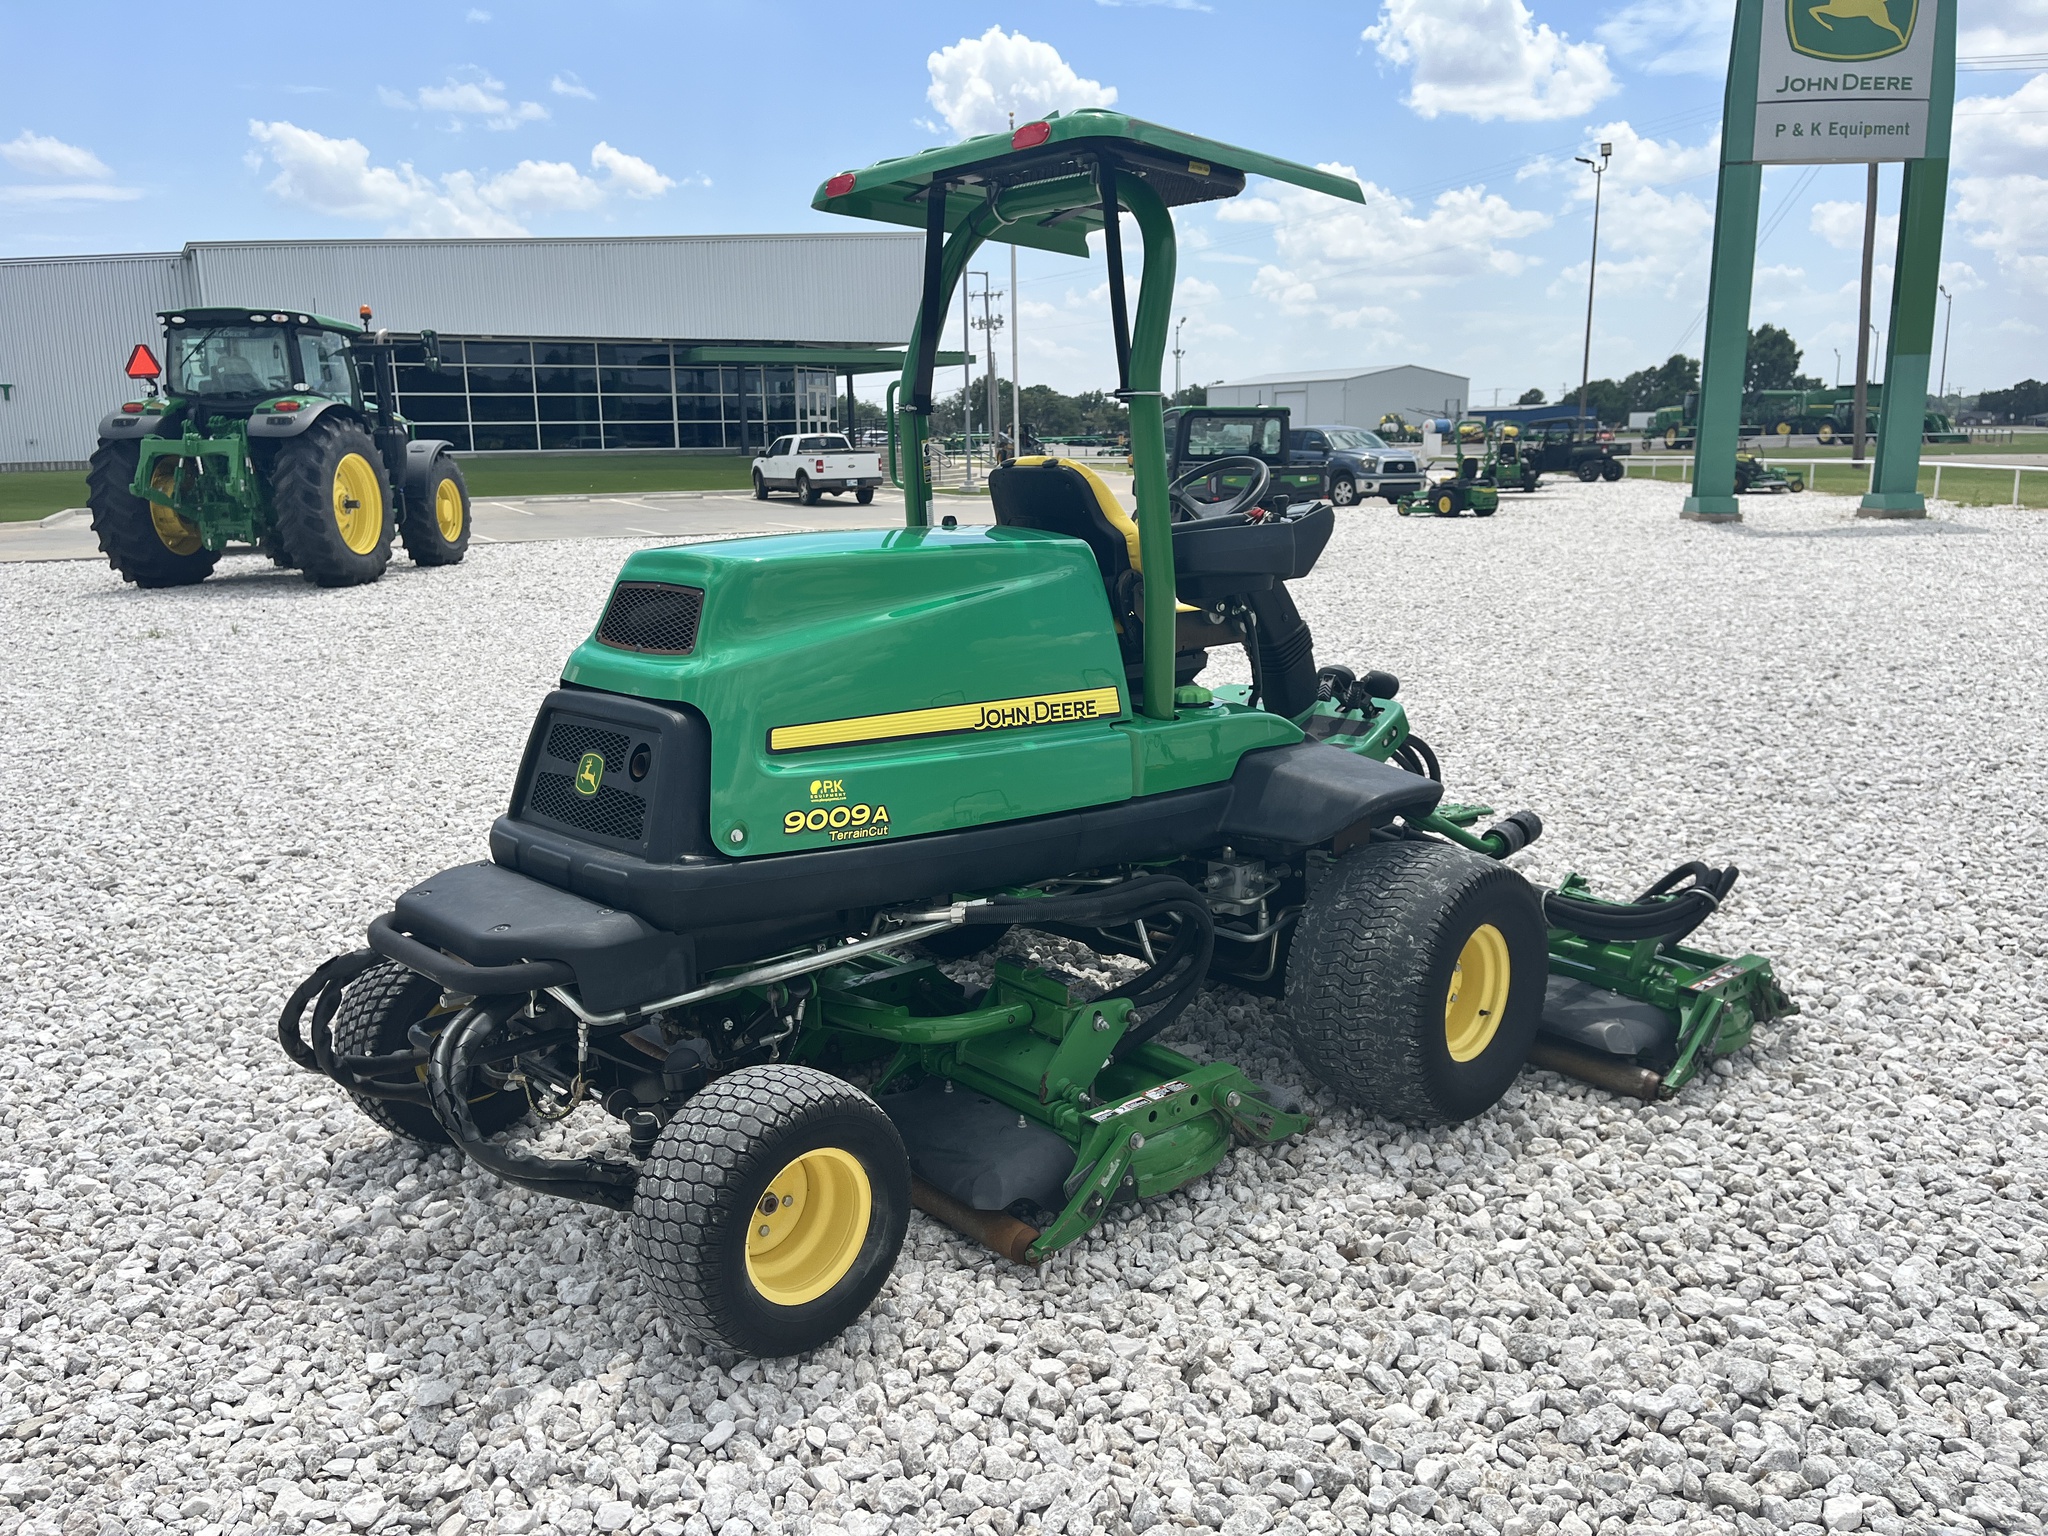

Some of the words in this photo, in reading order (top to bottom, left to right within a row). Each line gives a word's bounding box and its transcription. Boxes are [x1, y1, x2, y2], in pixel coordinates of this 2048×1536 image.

[1776, 76, 1838, 93] JOHN
[1843, 74, 1913, 91] DEERE
[1775, 123, 1787, 137] P
[1792, 123, 1804, 136] &
[1811, 122, 1822, 136] K
[1829, 121, 1910, 138] Equipment
[974, 706, 1030, 728] JOHN
[1034, 699, 1098, 721] DEERE
[828, 825, 889, 841] TerrainCut
